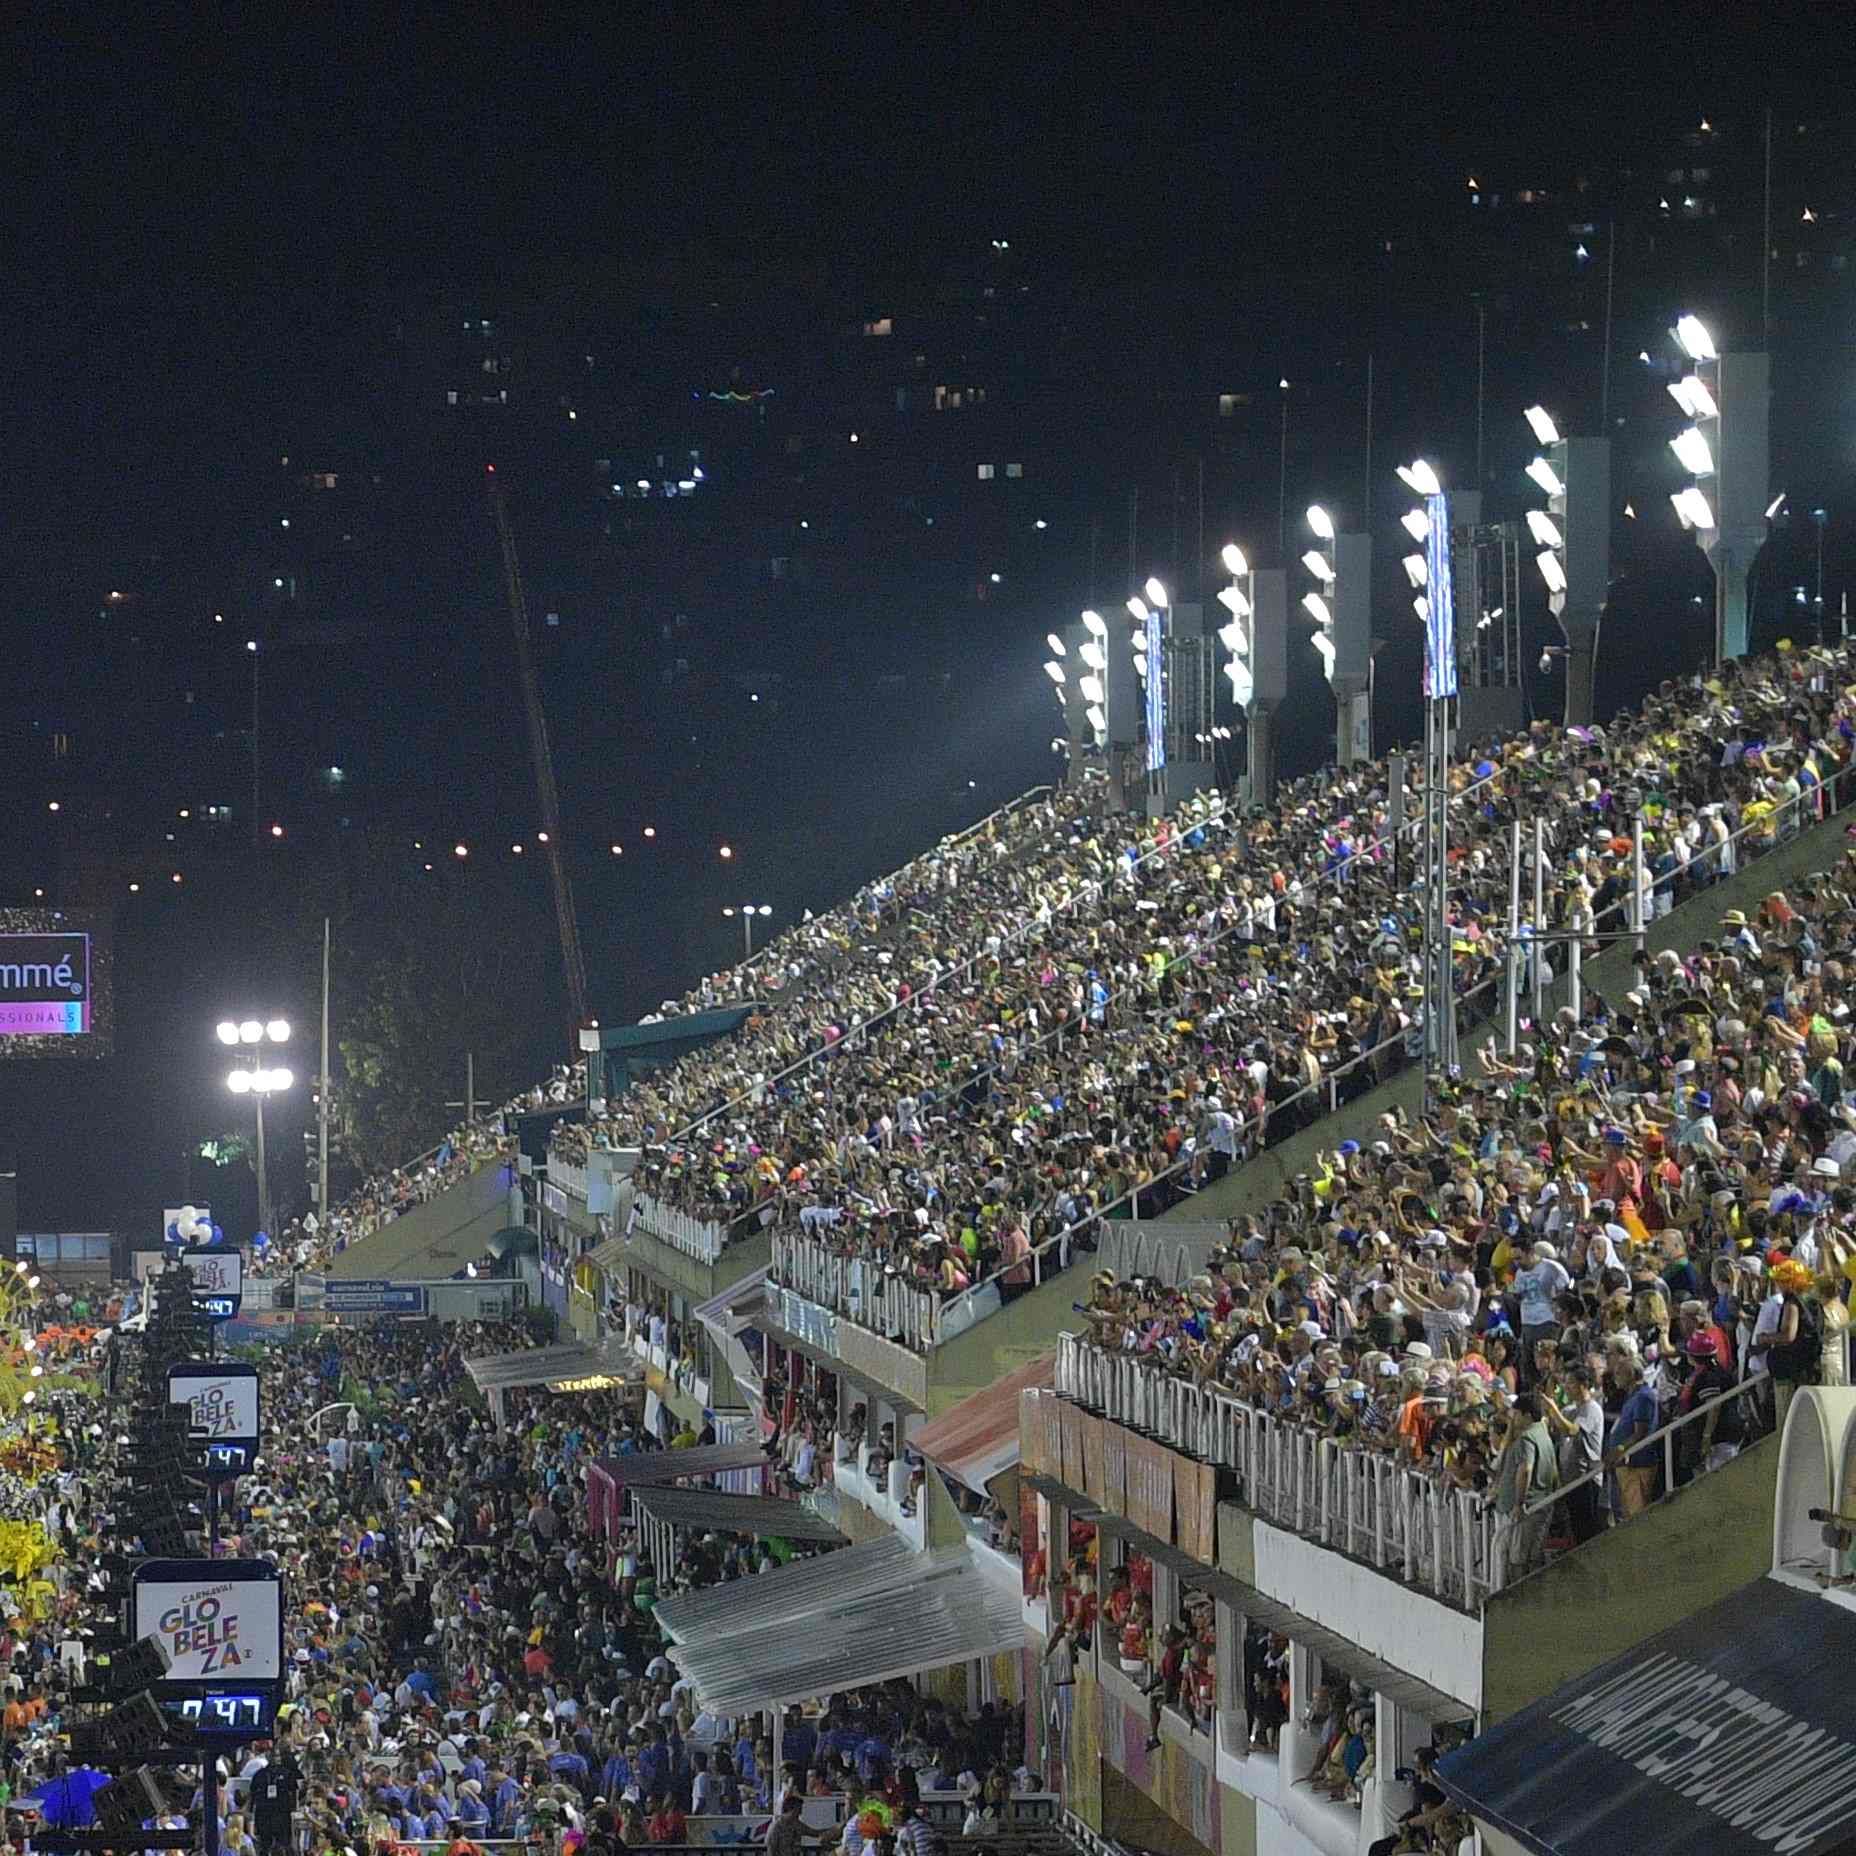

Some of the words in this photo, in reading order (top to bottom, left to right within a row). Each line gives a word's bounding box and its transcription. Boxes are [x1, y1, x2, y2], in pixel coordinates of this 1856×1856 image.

[195, 1400, 235, 1426] BELE
[210, 1416, 237, 1436] ZA
[159, 1597, 221, 1634] GLO
[174, 1615, 239, 1657] BELE
[200, 1641, 243, 1675] ZA
[1563, 1656, 1734, 1755] MAIOR
[1621, 1686, 1793, 1790] FESTA
[1680, 1720, 1828, 1809] DO
